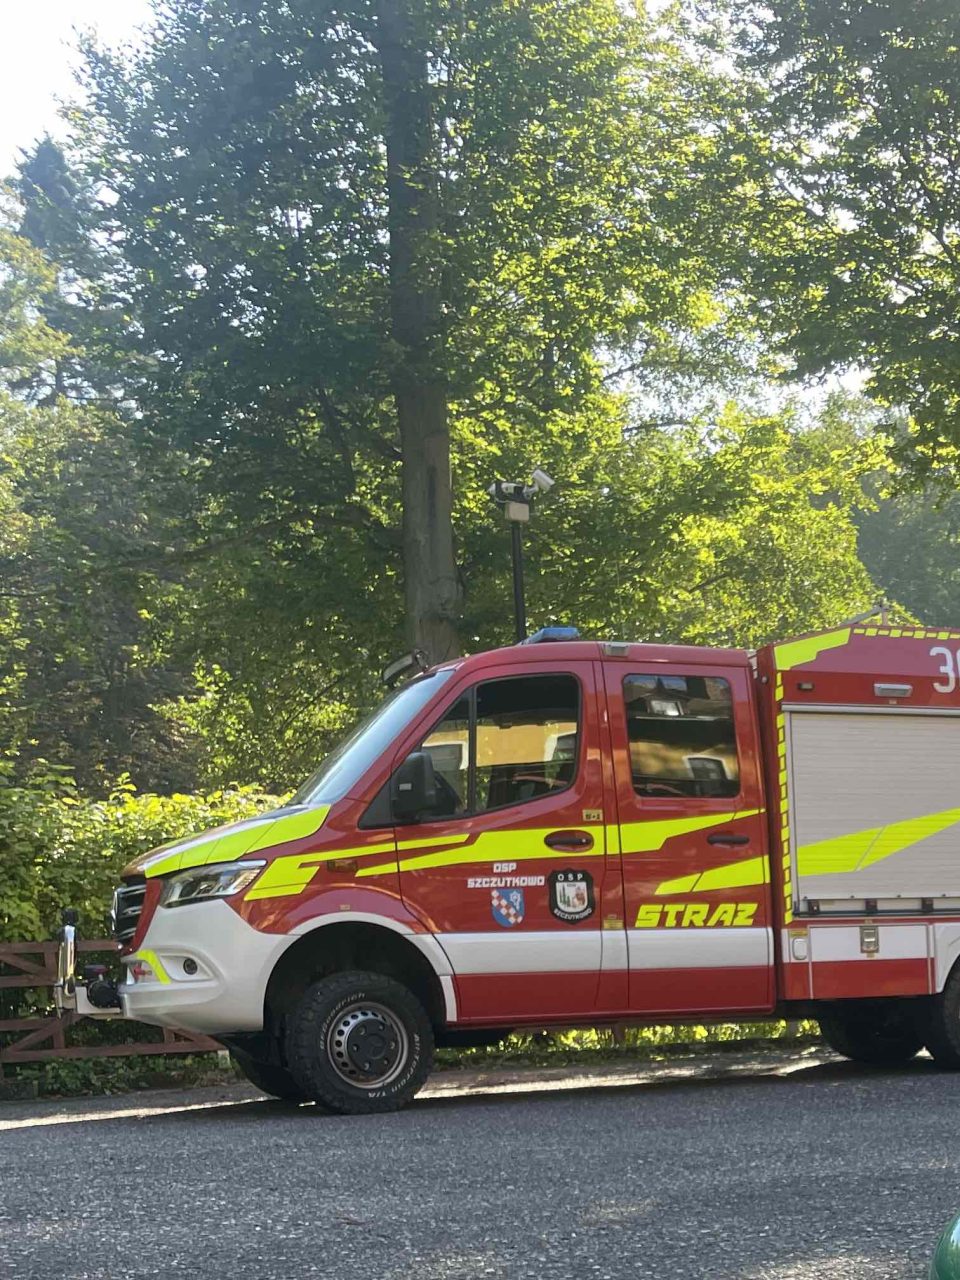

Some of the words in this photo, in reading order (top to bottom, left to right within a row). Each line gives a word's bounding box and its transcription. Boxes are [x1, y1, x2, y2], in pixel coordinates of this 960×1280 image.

[493, 862, 517, 873] OSP
[467, 875, 545, 888] SZCZUTKOWO
[557, 873, 583, 882] OSP
